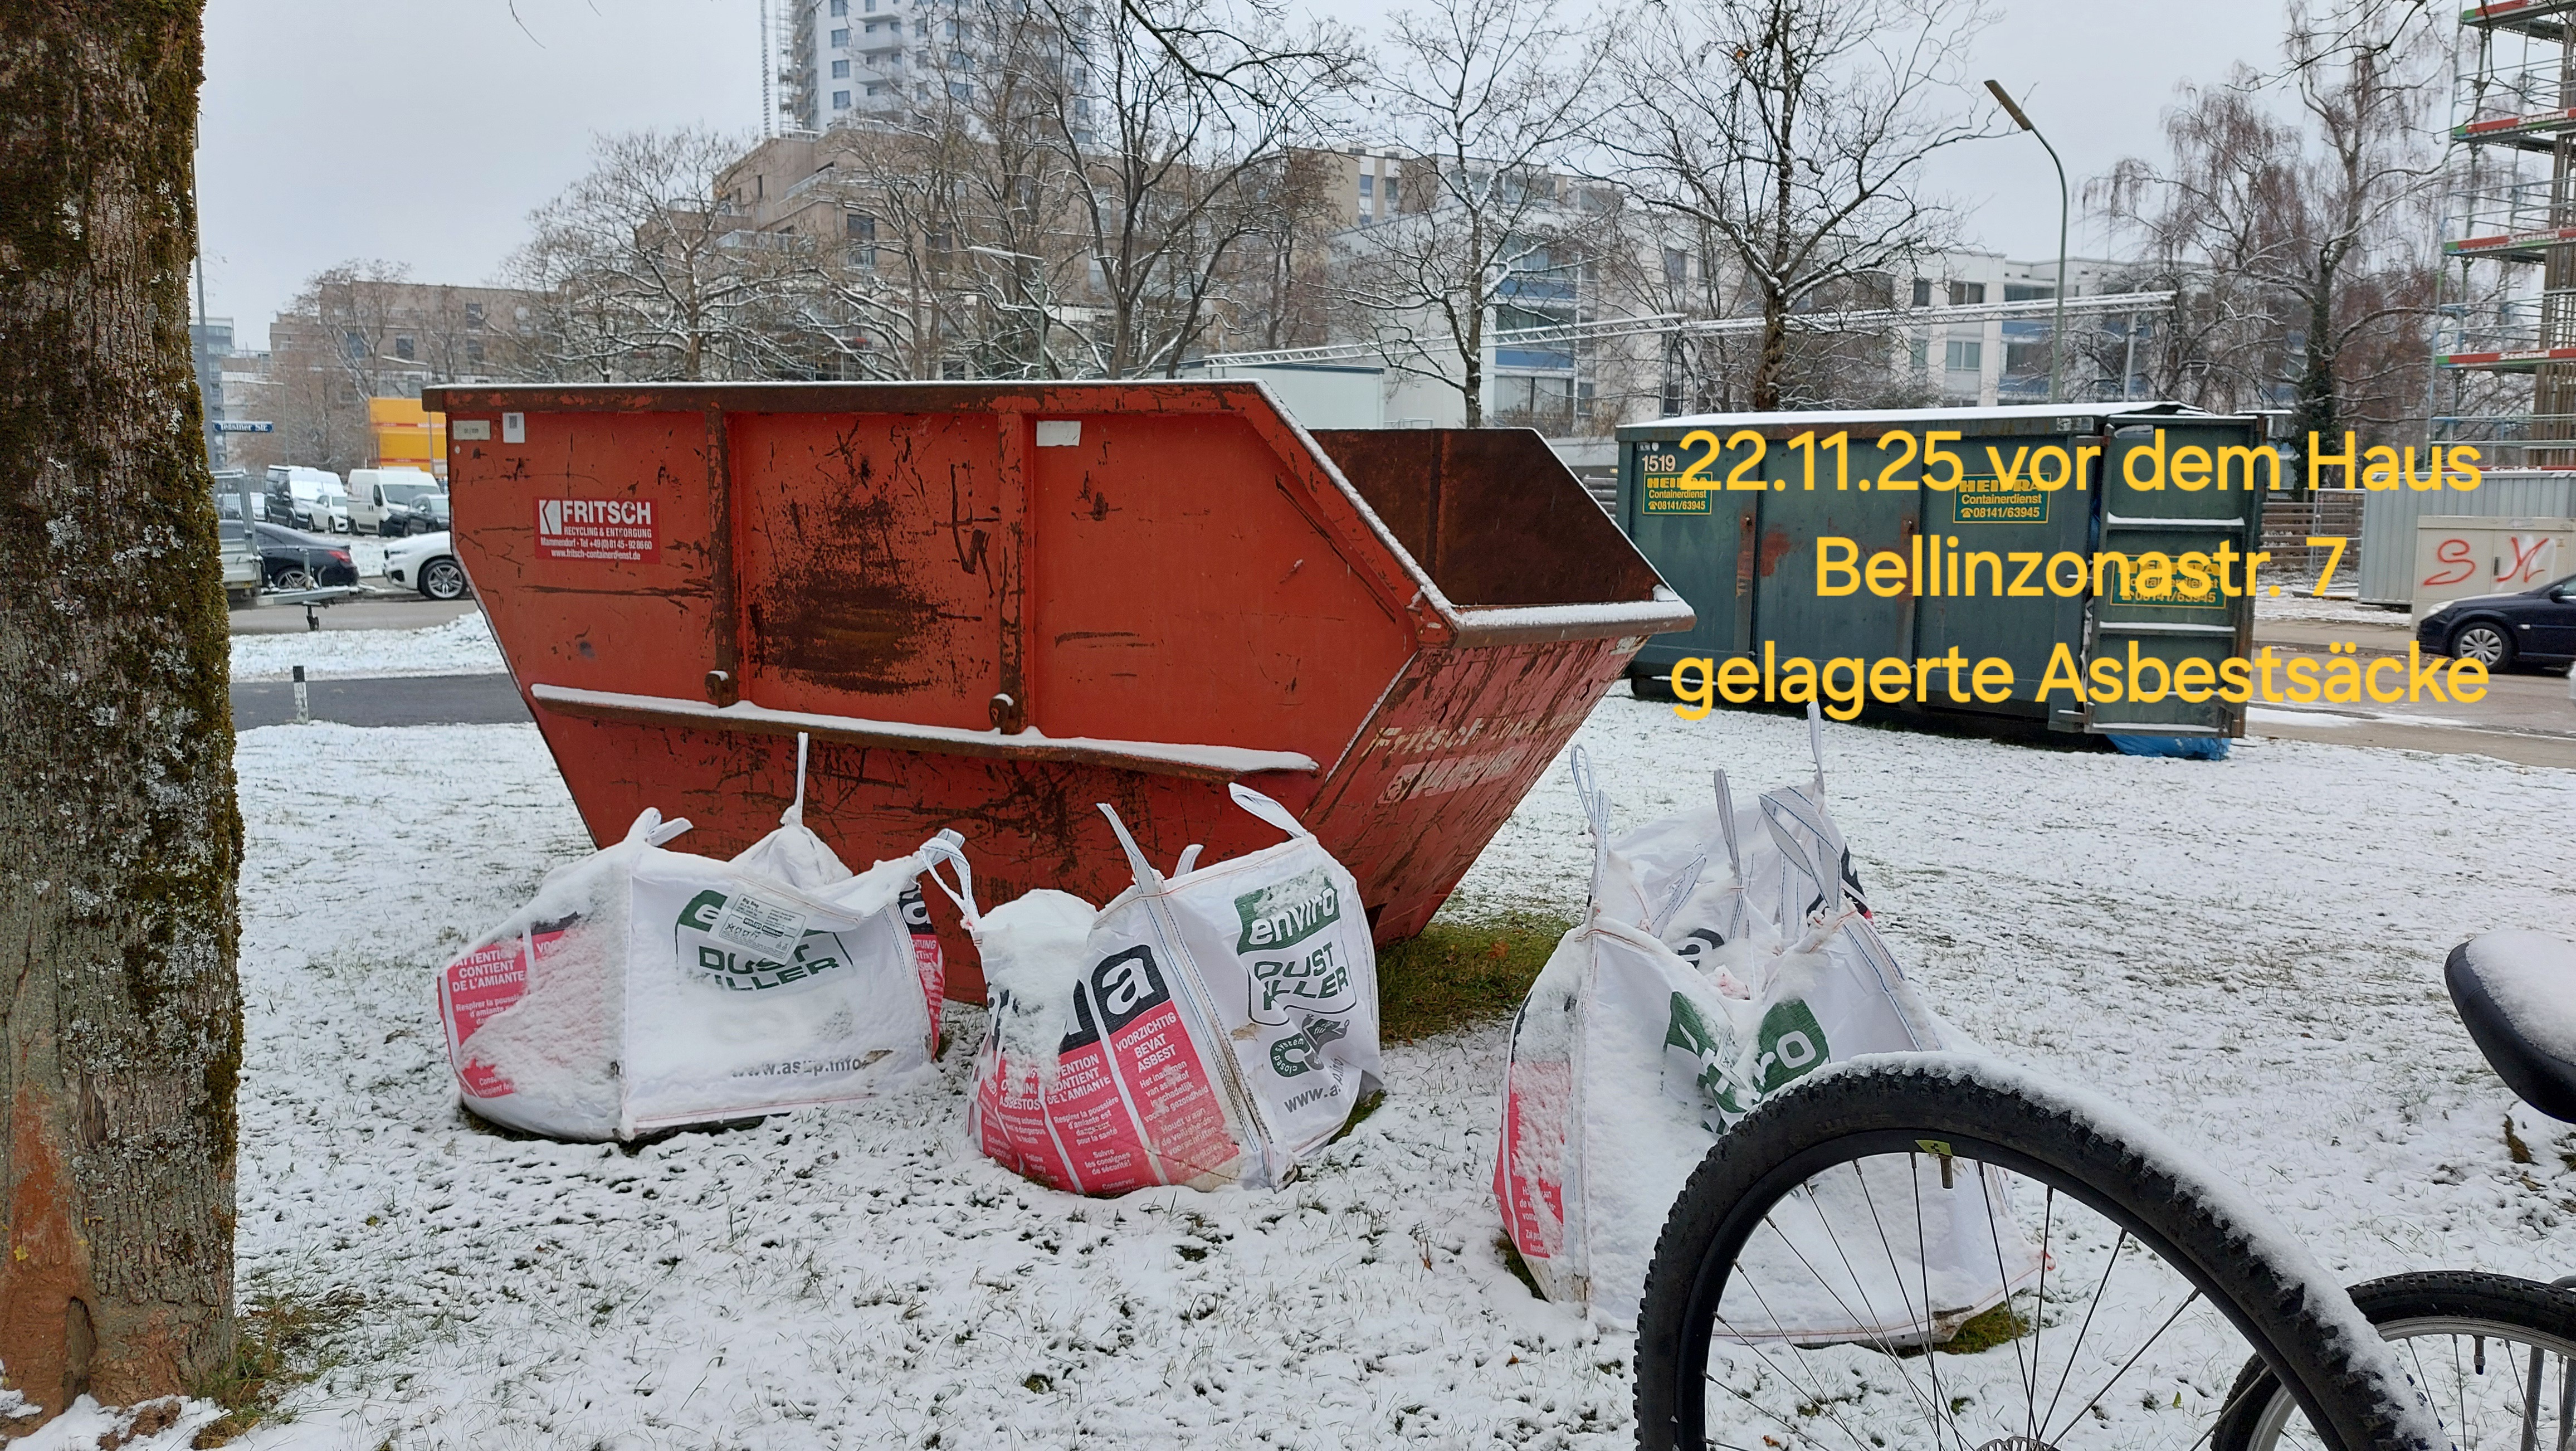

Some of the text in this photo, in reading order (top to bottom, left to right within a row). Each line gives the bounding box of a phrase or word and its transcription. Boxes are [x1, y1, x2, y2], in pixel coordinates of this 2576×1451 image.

[1642, 455, 1676, 471] 1519
[1649, 490, 1707, 498] Containerdienst
[1962, 494, 2042, 504] Containerdienst
[563, 500, 651, 525] FRITSCH
[1657, 501, 1705, 510] 08141/63945
[1973, 507, 2040, 518] 08141/63945
[564, 526, 598, 537] RECYCLING
[599, 528, 604, 536] &
[1248, 888, 1335, 945] enviro
[455, 949, 501, 967] ATTENTI
[1254, 941, 1334, 981] DUST
[459, 960, 515, 980] CONTIENT
[691, 957, 840, 991] ILLER
[452, 971, 525, 992] DE L'AMIANTE
[495, 994, 520, 1006] poussi
[1115, 1012, 1177, 1052] VOORZICHTIG
[1134, 1033, 1167, 1059] BEVAT
[1275, 1038, 1304, 1052] system
[732, 1056, 861, 1077] w.asp.info
[1058, 1054, 1100, 1077] ENTION
[1137, 1044, 1175, 1073] ASBEST
[1273, 1055, 1297, 1074] closed
[1139, 1061, 1187, 1089] Het inamen
[1047, 1075, 1111, 1105] DE L'AMIANTE
[1145, 1086, 1160, 1097] van
[1170, 1084, 1209, 1112] gezondheid
[999, 1094, 1041, 1111] ASBESTOS
[1053, 1113, 1080, 1124] Respirer
[1100, 1109, 1112, 1119] est
[1160, 1117, 1185, 1134] Houdt
[1092, 1148, 1115, 1158] Suivre
[1096, 1152, 1131, 1166] consignes
[1092, 1167, 1101, 1176] de
